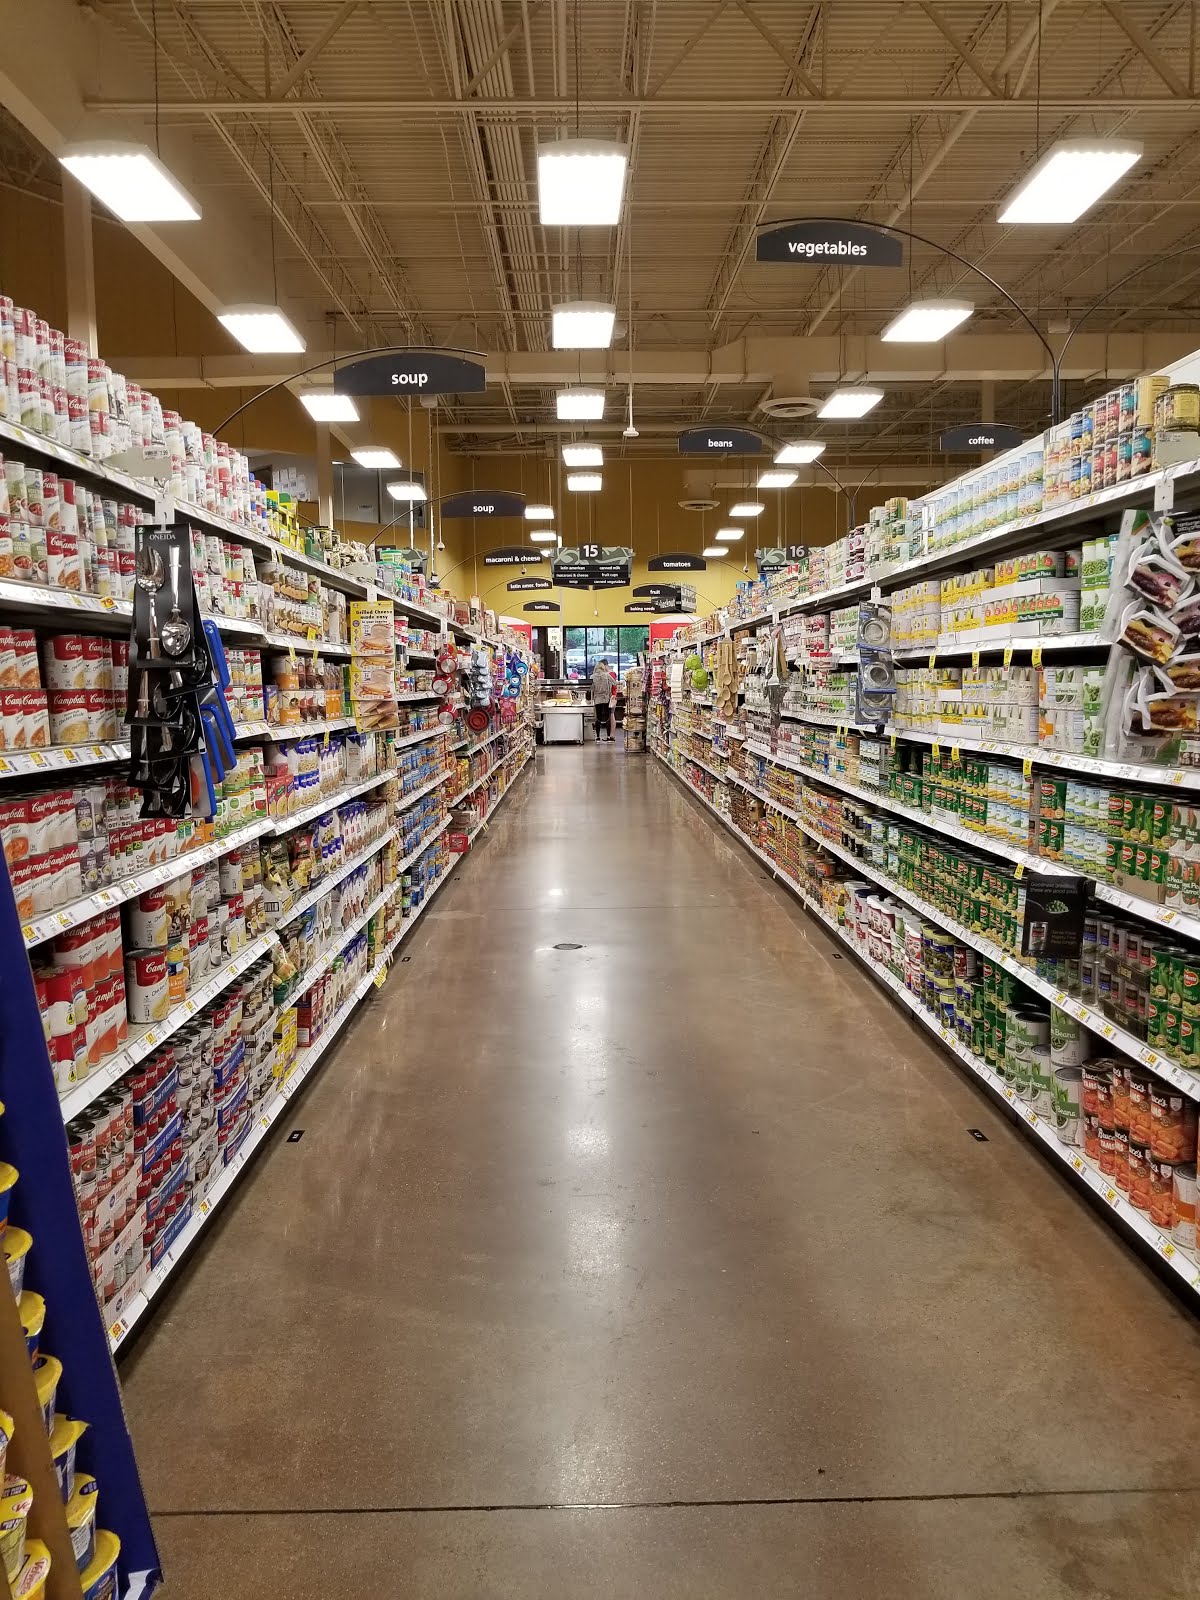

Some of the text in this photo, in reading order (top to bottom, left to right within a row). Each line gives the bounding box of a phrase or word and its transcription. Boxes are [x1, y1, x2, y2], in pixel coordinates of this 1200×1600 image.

[788, 240, 868, 257] vegetables
[391, 373, 429, 387] soup
[707, 438, 733, 448] beans
[968, 435, 995, 445] coffee
[472, 505, 495, 513] soup
[583, 544, 599, 558] 15
[789, 545, 806, 558] 16
[485, 556, 513, 564] macaroni
[1053, 1028, 1076, 1039] Beans
